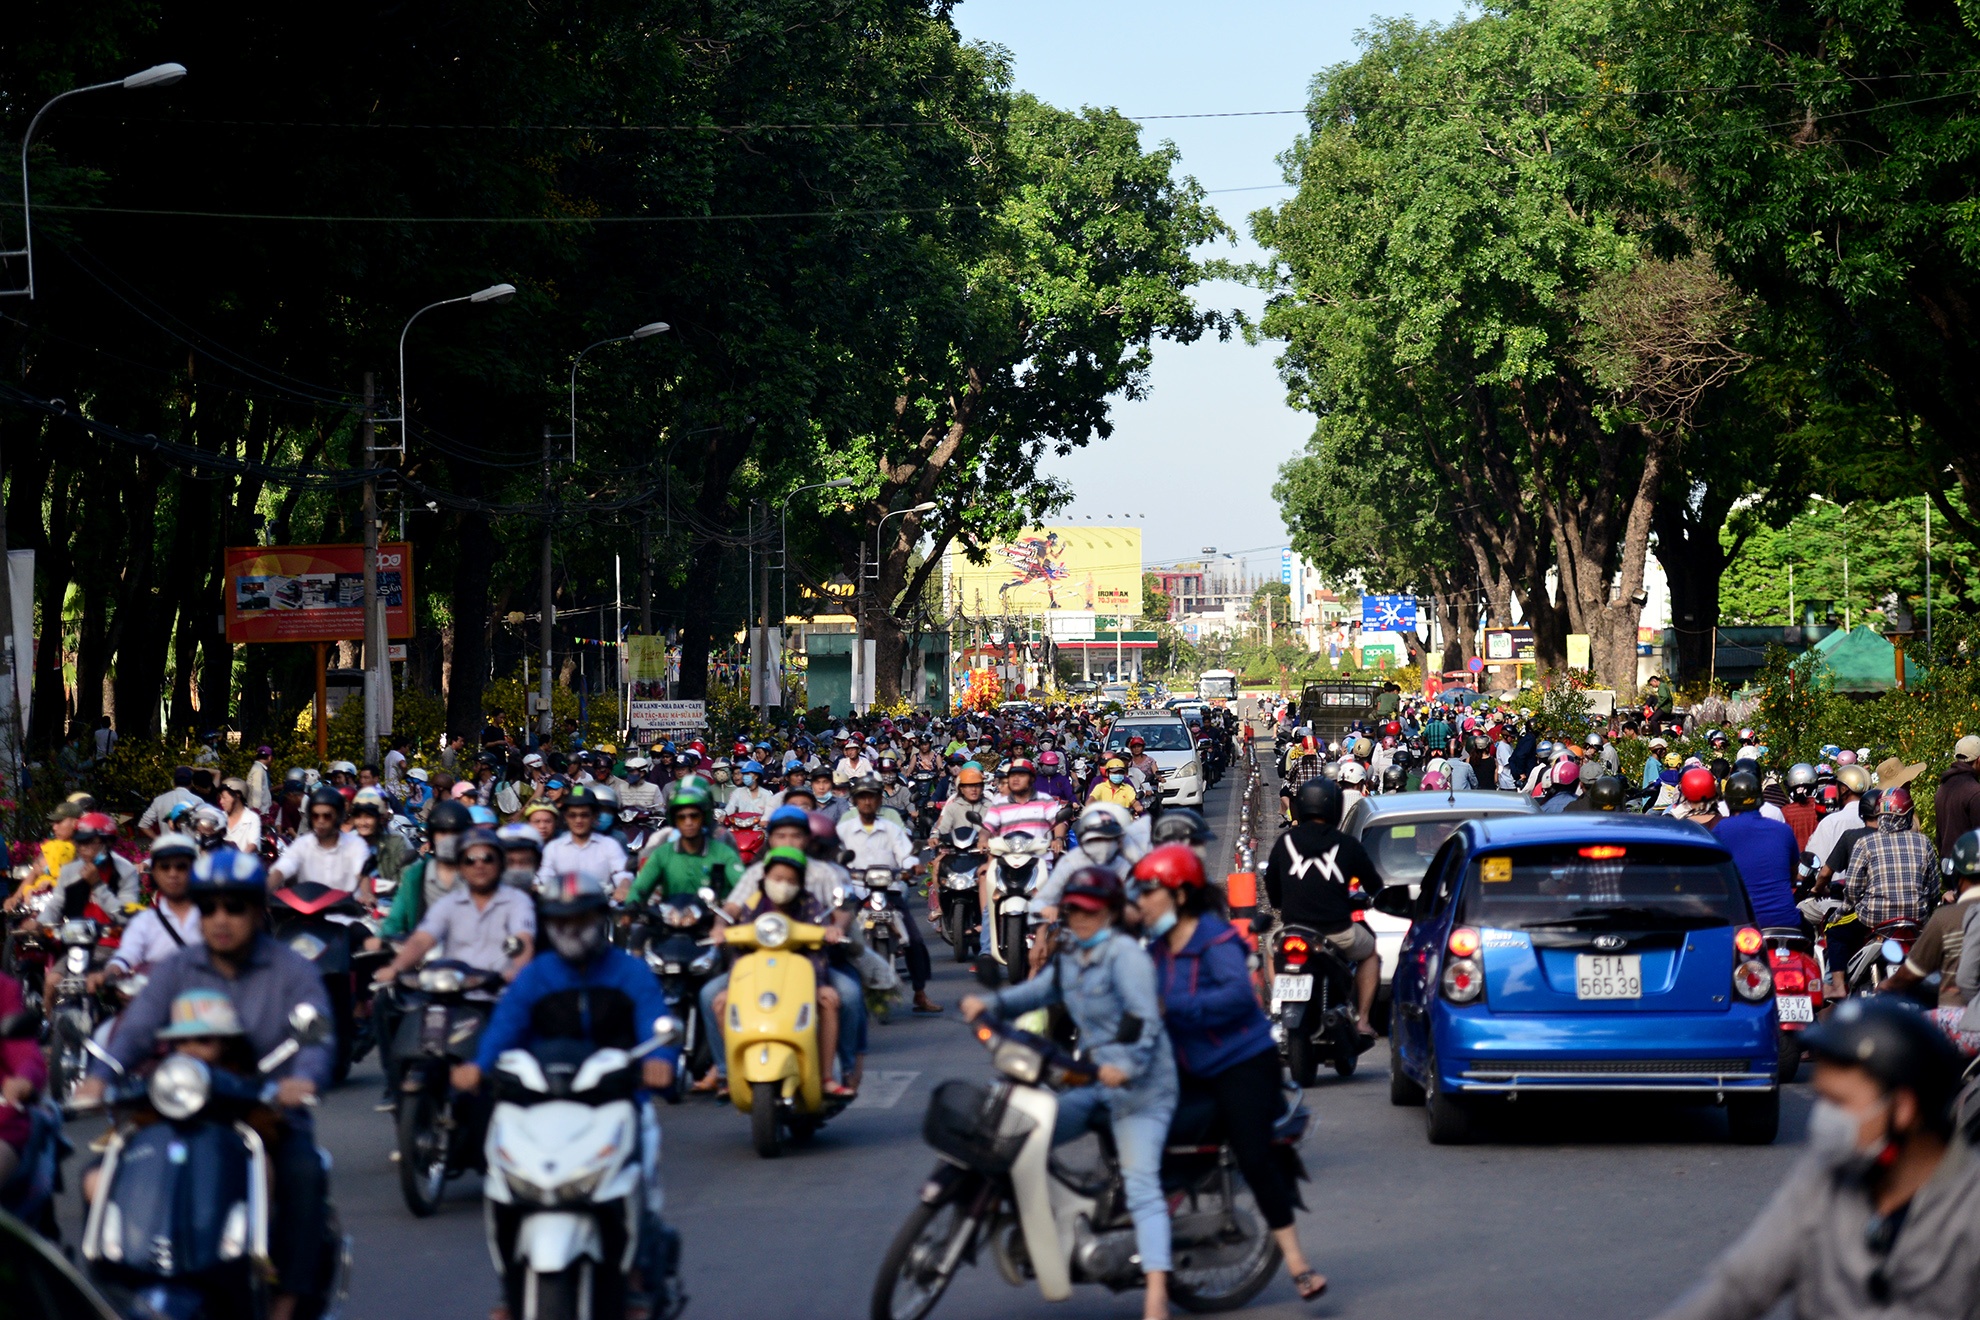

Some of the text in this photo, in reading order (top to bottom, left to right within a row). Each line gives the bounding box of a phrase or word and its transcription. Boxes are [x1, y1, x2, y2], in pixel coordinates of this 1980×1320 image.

[1593, 958, 1625, 976] 51A
[1580, 978, 1639, 996] 565.39
[1780, 998, 1806, 1009] 59-V2
